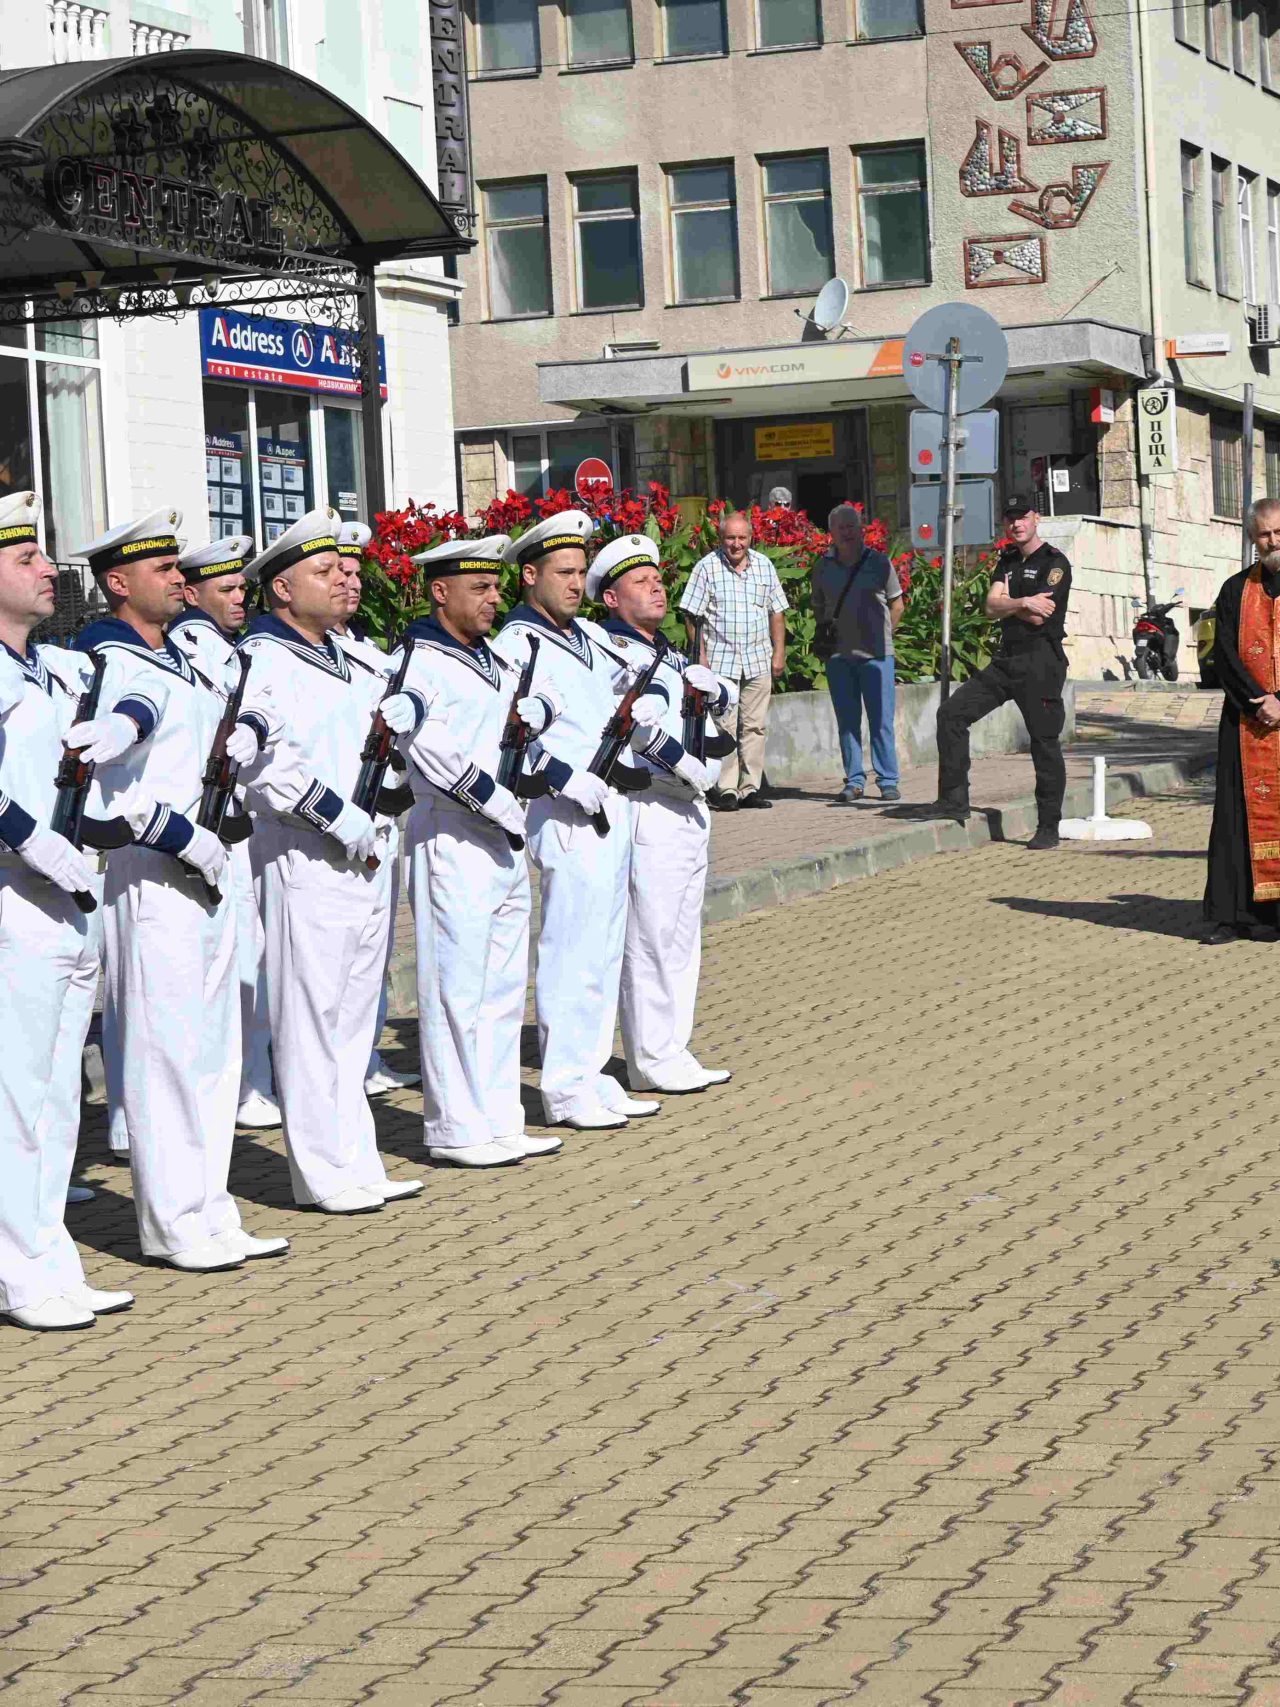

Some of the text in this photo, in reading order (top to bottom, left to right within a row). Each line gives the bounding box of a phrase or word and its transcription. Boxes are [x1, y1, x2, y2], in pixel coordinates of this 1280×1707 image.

[429, 0, 467, 206] ENTRAL
[53, 156, 284, 251] CENTRAL
[211, 317, 284, 356] Address
[211, 364, 284, 383] real estate
[735, 362, 805, 376] VIVACOM
[211, 435, 234, 448] Address
[1149, 420, 1166, 467] ПОЩА
